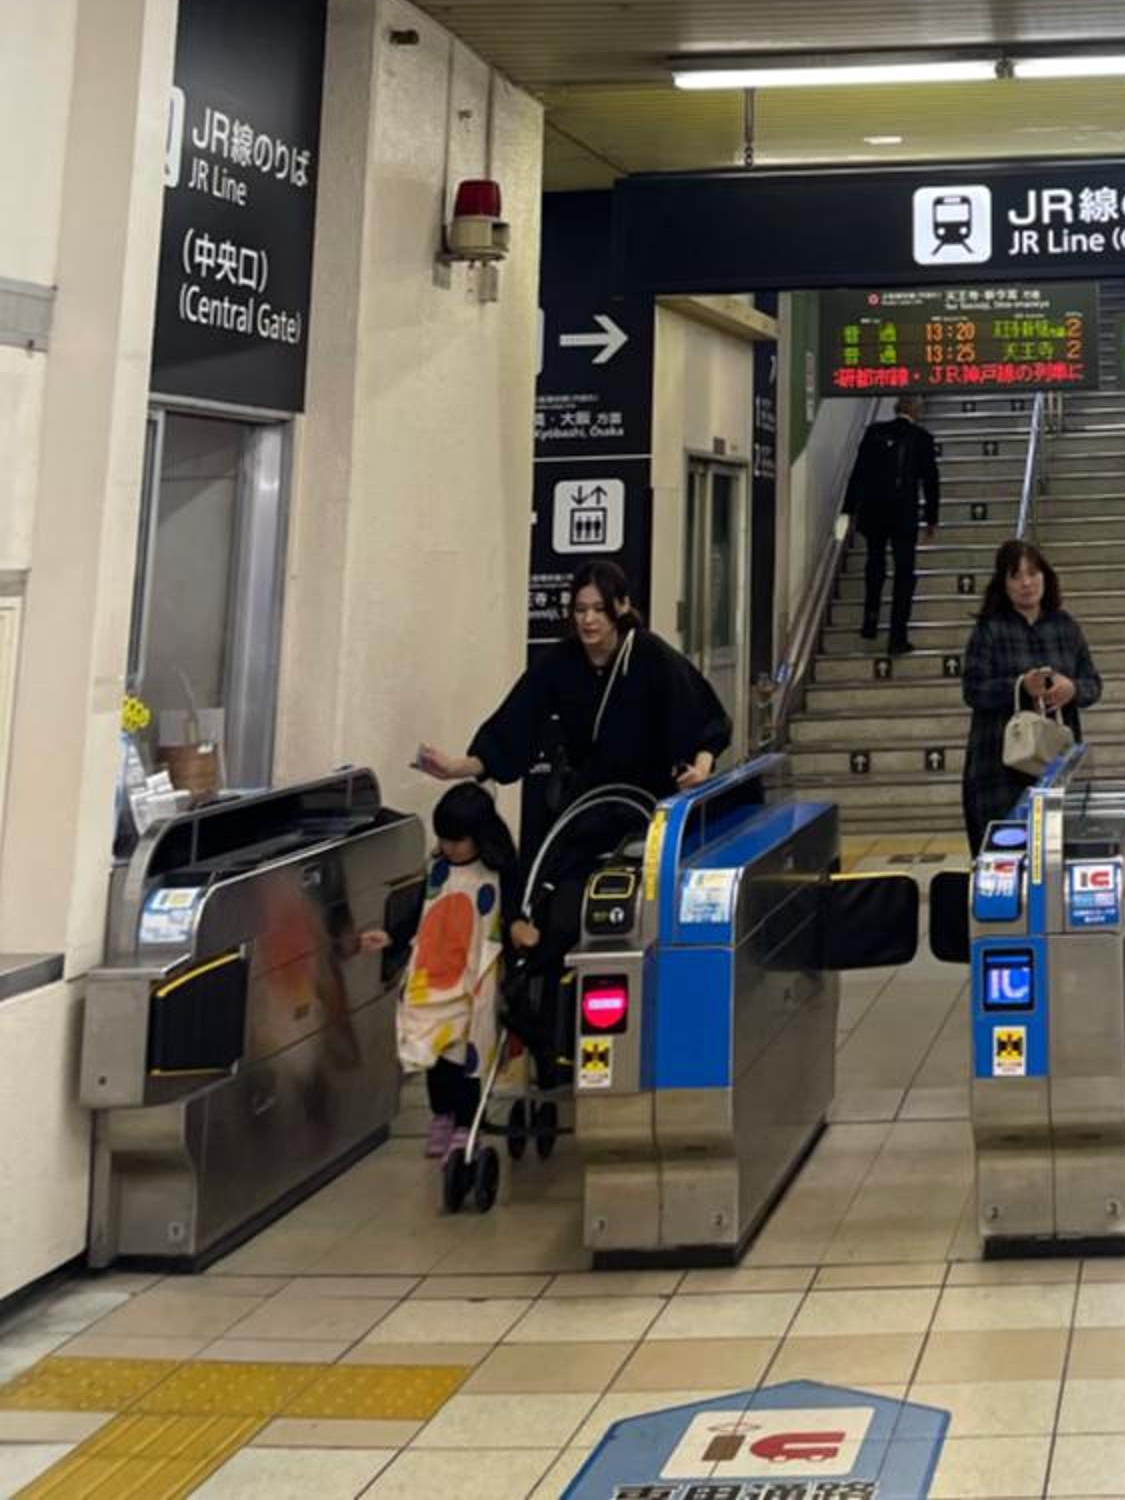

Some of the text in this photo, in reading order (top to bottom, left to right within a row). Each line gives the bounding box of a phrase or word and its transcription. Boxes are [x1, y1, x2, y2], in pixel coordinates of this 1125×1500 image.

[193, 107, 312, 187] JR線のりば
[188, 156, 248, 207] JR Line
[183, 227, 270, 293] (中央口)
[1009, 231, 1040, 256] JR
[1047, 229, 1106, 254] Line
[179, 283, 255, 335] (Central
[925, 322, 977, 342] 13:20
[1064, 317, 1083, 338] 2
[925, 343, 977, 363] 13:25
[1065, 339, 1084, 360] 2
